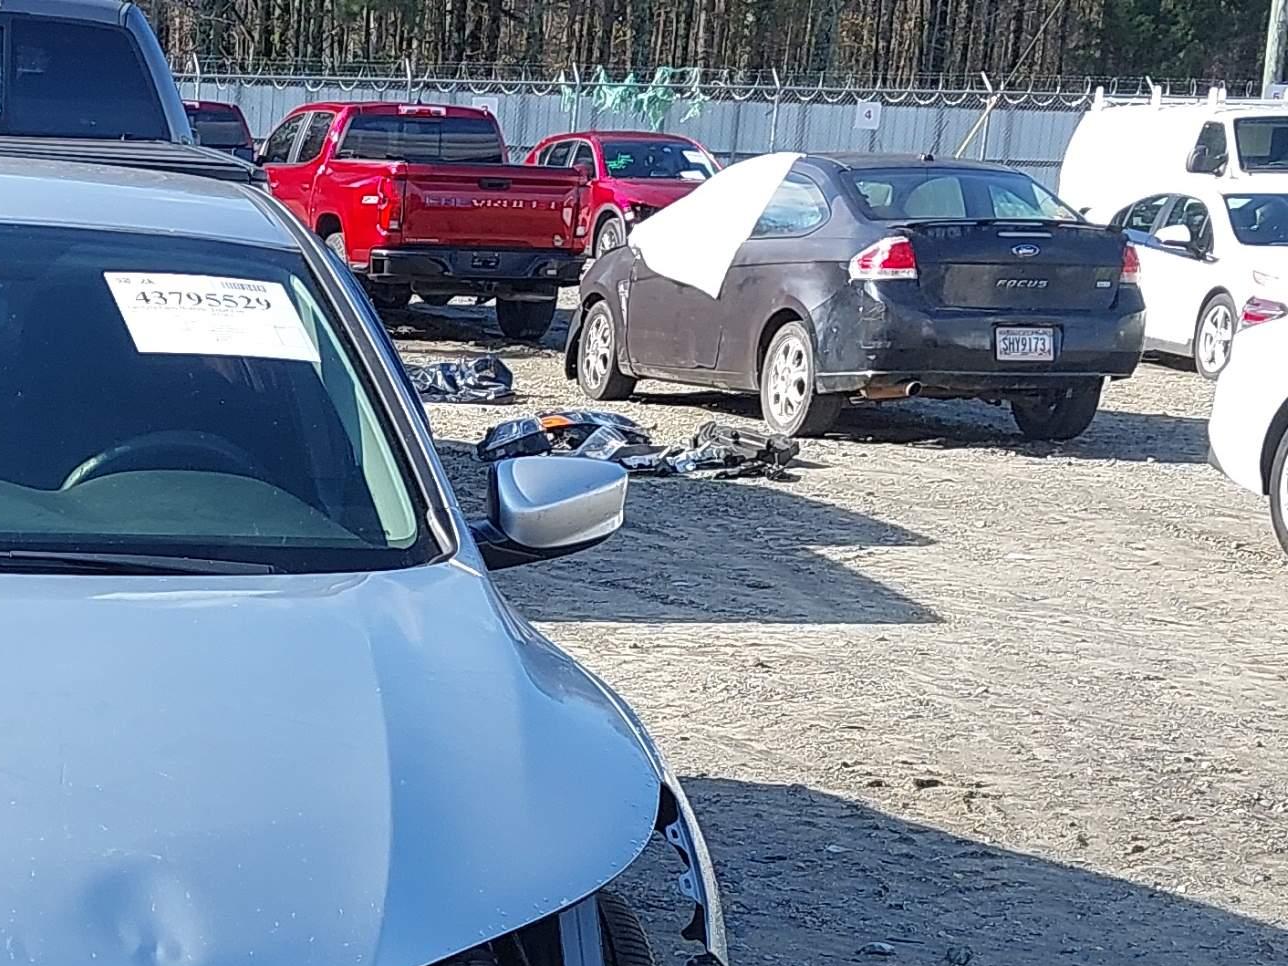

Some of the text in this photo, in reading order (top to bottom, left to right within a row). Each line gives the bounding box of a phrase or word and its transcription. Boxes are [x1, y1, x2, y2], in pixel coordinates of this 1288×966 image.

[865, 110, 872, 119] 4
[996, 279, 1049, 289] FOCUS
[135, 291, 271, 311] 43795529
[1002, 336, 1046, 352] SHY9173
